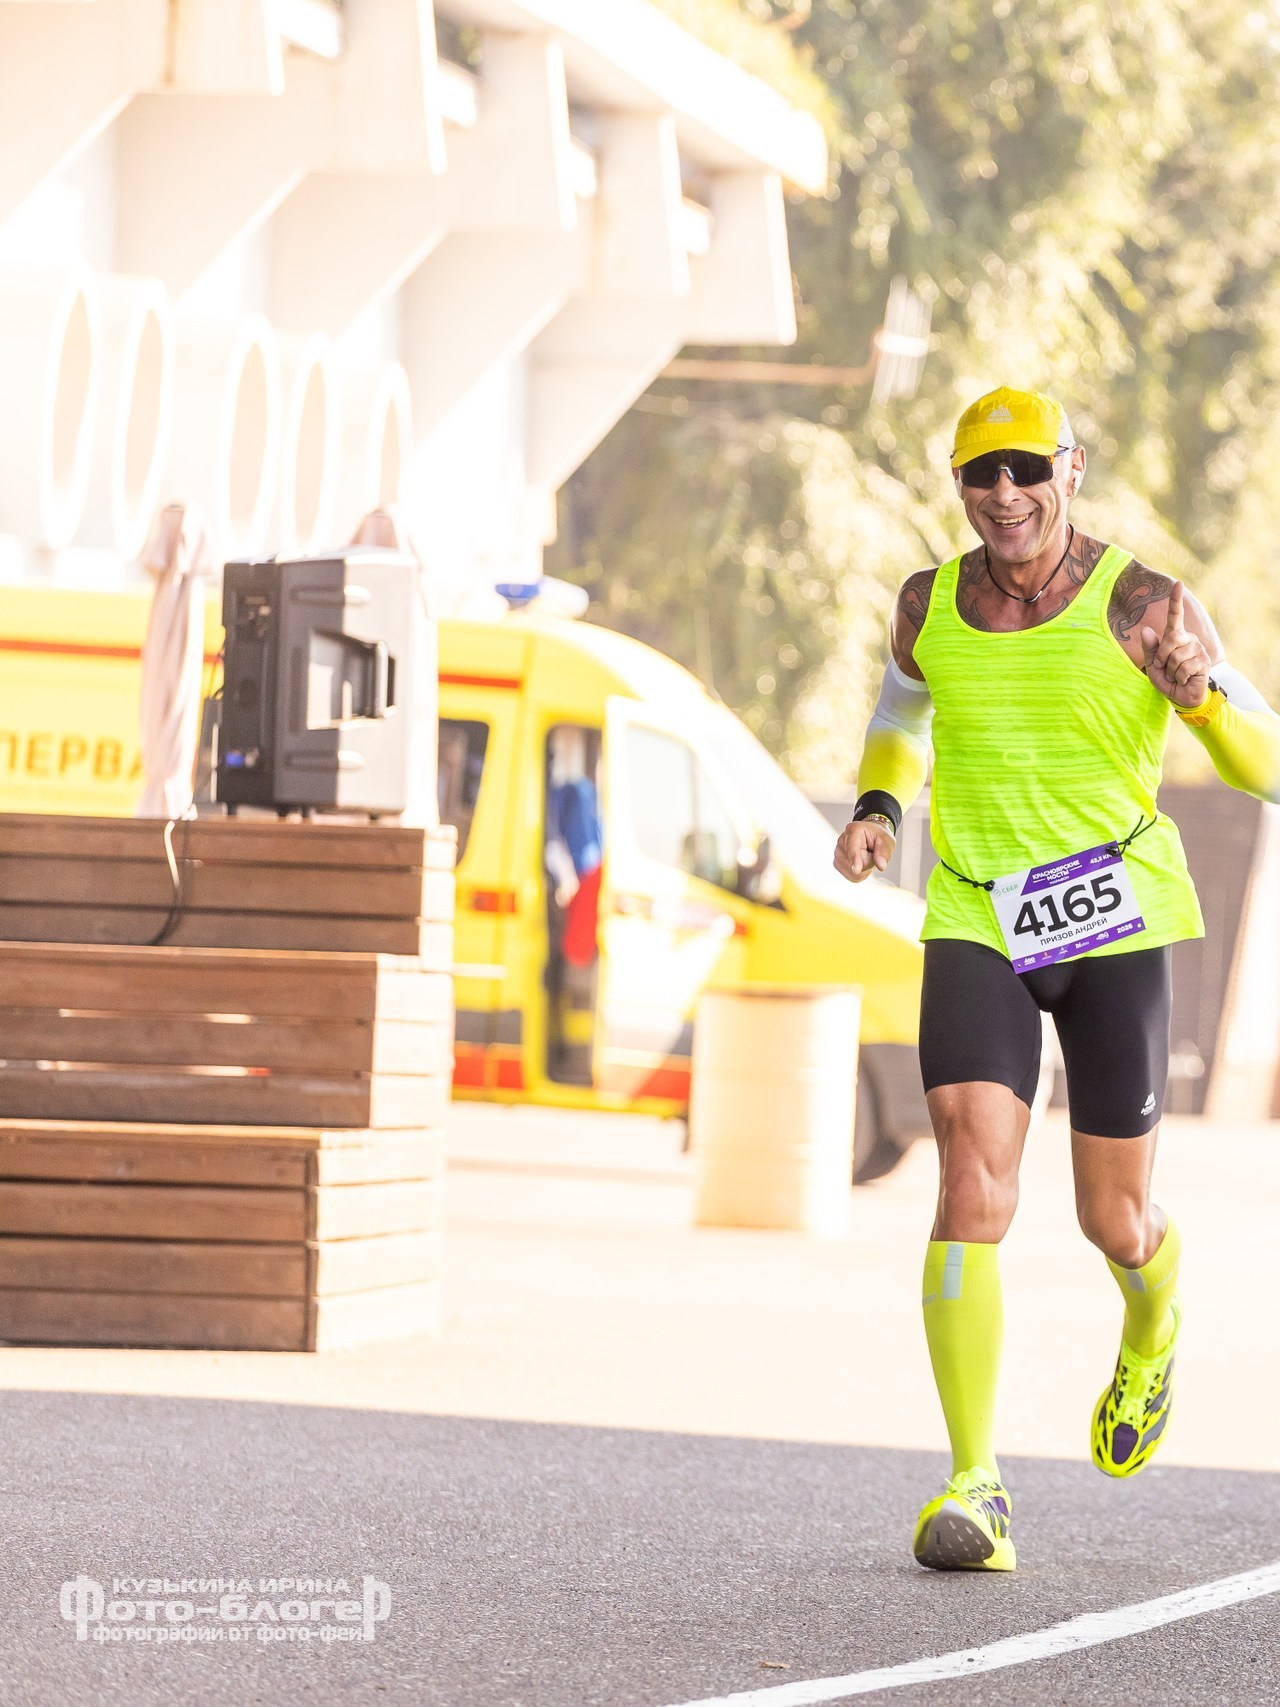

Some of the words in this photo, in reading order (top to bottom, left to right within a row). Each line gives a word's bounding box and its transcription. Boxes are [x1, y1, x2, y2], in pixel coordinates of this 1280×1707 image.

[1032, 860, 1080, 880] КРАСНОЯРСКИЕ
[1047, 869, 1069, 882] МОСТЫ
[1002, 883, 1019, 894] СБЕР
[1013, 873, 1122, 937] 4165
[1040, 930, 1074, 946] ПРИЗОВ
[1075, 917, 1108, 935] АНДРЕЙ
